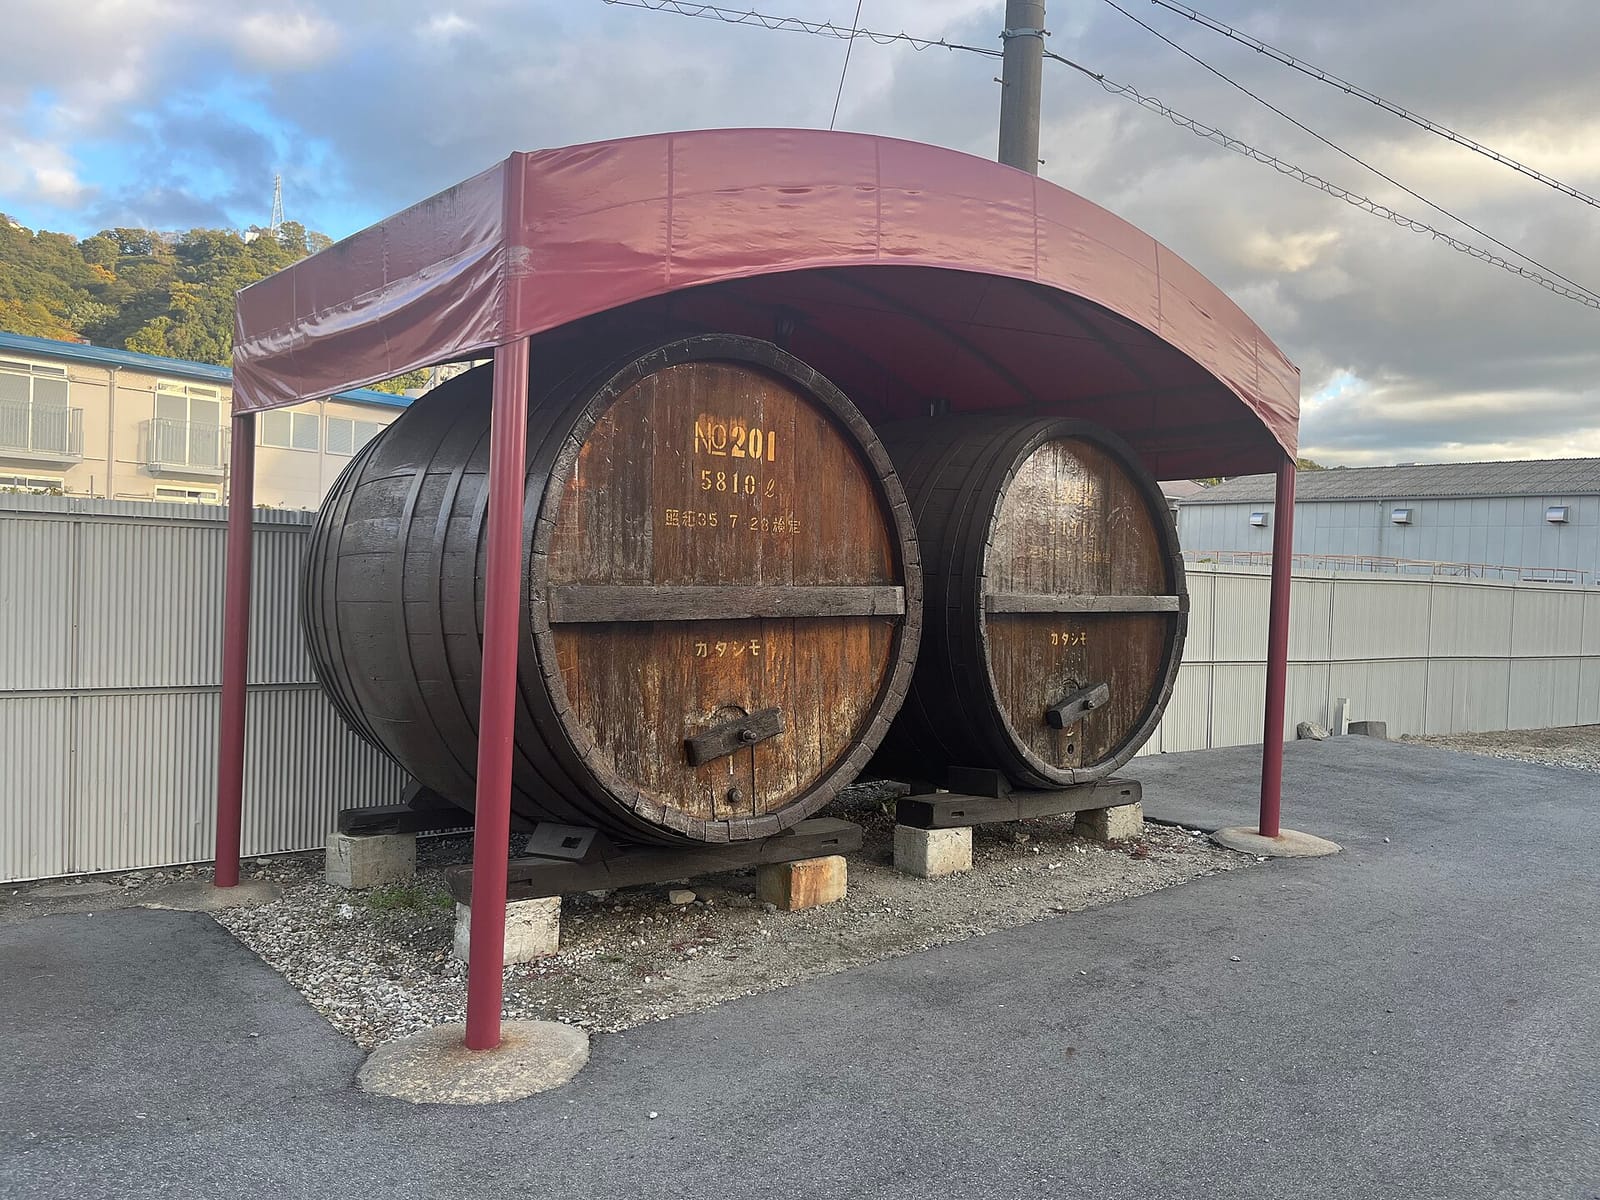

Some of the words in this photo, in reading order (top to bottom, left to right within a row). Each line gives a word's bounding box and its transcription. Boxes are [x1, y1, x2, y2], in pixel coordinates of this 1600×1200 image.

[701, 469, 756, 495] 5810
[729, 514, 738, 528] 7
[1050, 631, 1087, 646] カタシモ
[695, 639, 760, 657] カタシモ
